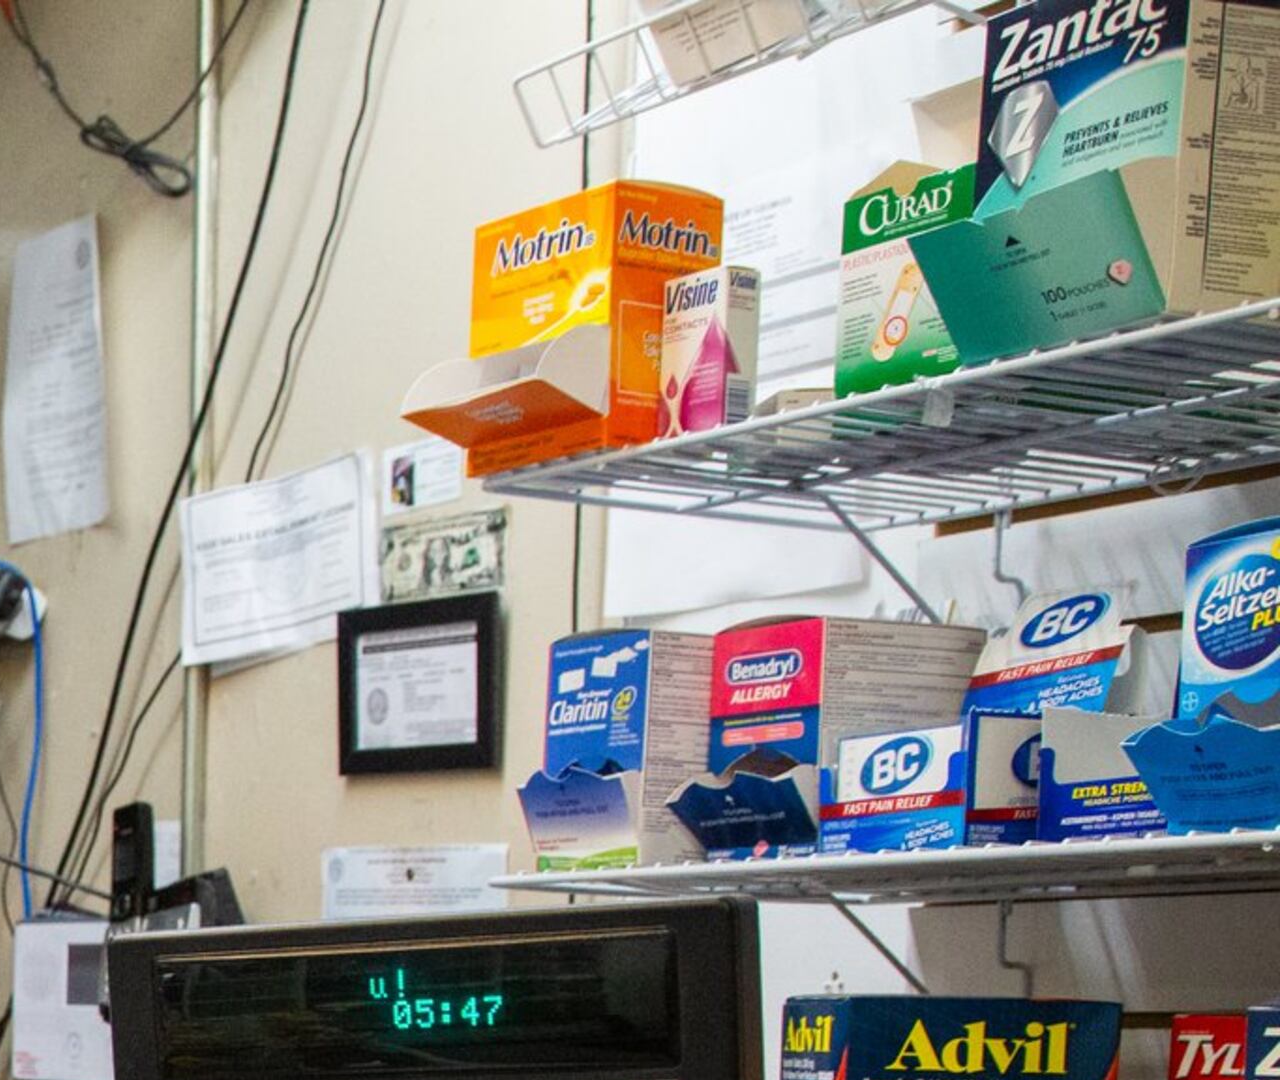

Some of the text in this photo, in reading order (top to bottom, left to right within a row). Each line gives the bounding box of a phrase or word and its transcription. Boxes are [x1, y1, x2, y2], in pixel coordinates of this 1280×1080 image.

[1122, 21, 1168, 64] 75
[1064, 101, 1169, 145] PREVENTS & RELIEVES
[1062, 131, 1119, 158] HEARTBURN
[859, 187, 952, 236] CURAD
[493, 219, 585, 276] Motrin
[620, 210, 709, 254] Motrin
[666, 278, 719, 315] Visine
[1041, 286, 1067, 305] 100
[1204, 566, 1275, 606] Alka-
[1031, 600, 1095, 643] BC
[731, 655, 795, 681] Benadryl
[996, 653, 1094, 682] FAST PAIN RELIEF
[730, 682, 792, 704] ALLERGY
[1038, 676, 1099, 699] HEADACHES
[549, 698, 608, 725] Claritin
[872, 743, 921, 790] BC
[843, 795, 934, 816] FAST PAIN RELIEF
[1072, 782, 1148, 799] EXTRA STREN
[370, 967, 406, 998] u!
[393, 995, 503, 1030] 05:47
[785, 1015, 833, 1052] Advil
[885, 1018, 1072, 1076] Advil
[1176, 1034, 1245, 1079] TYL
